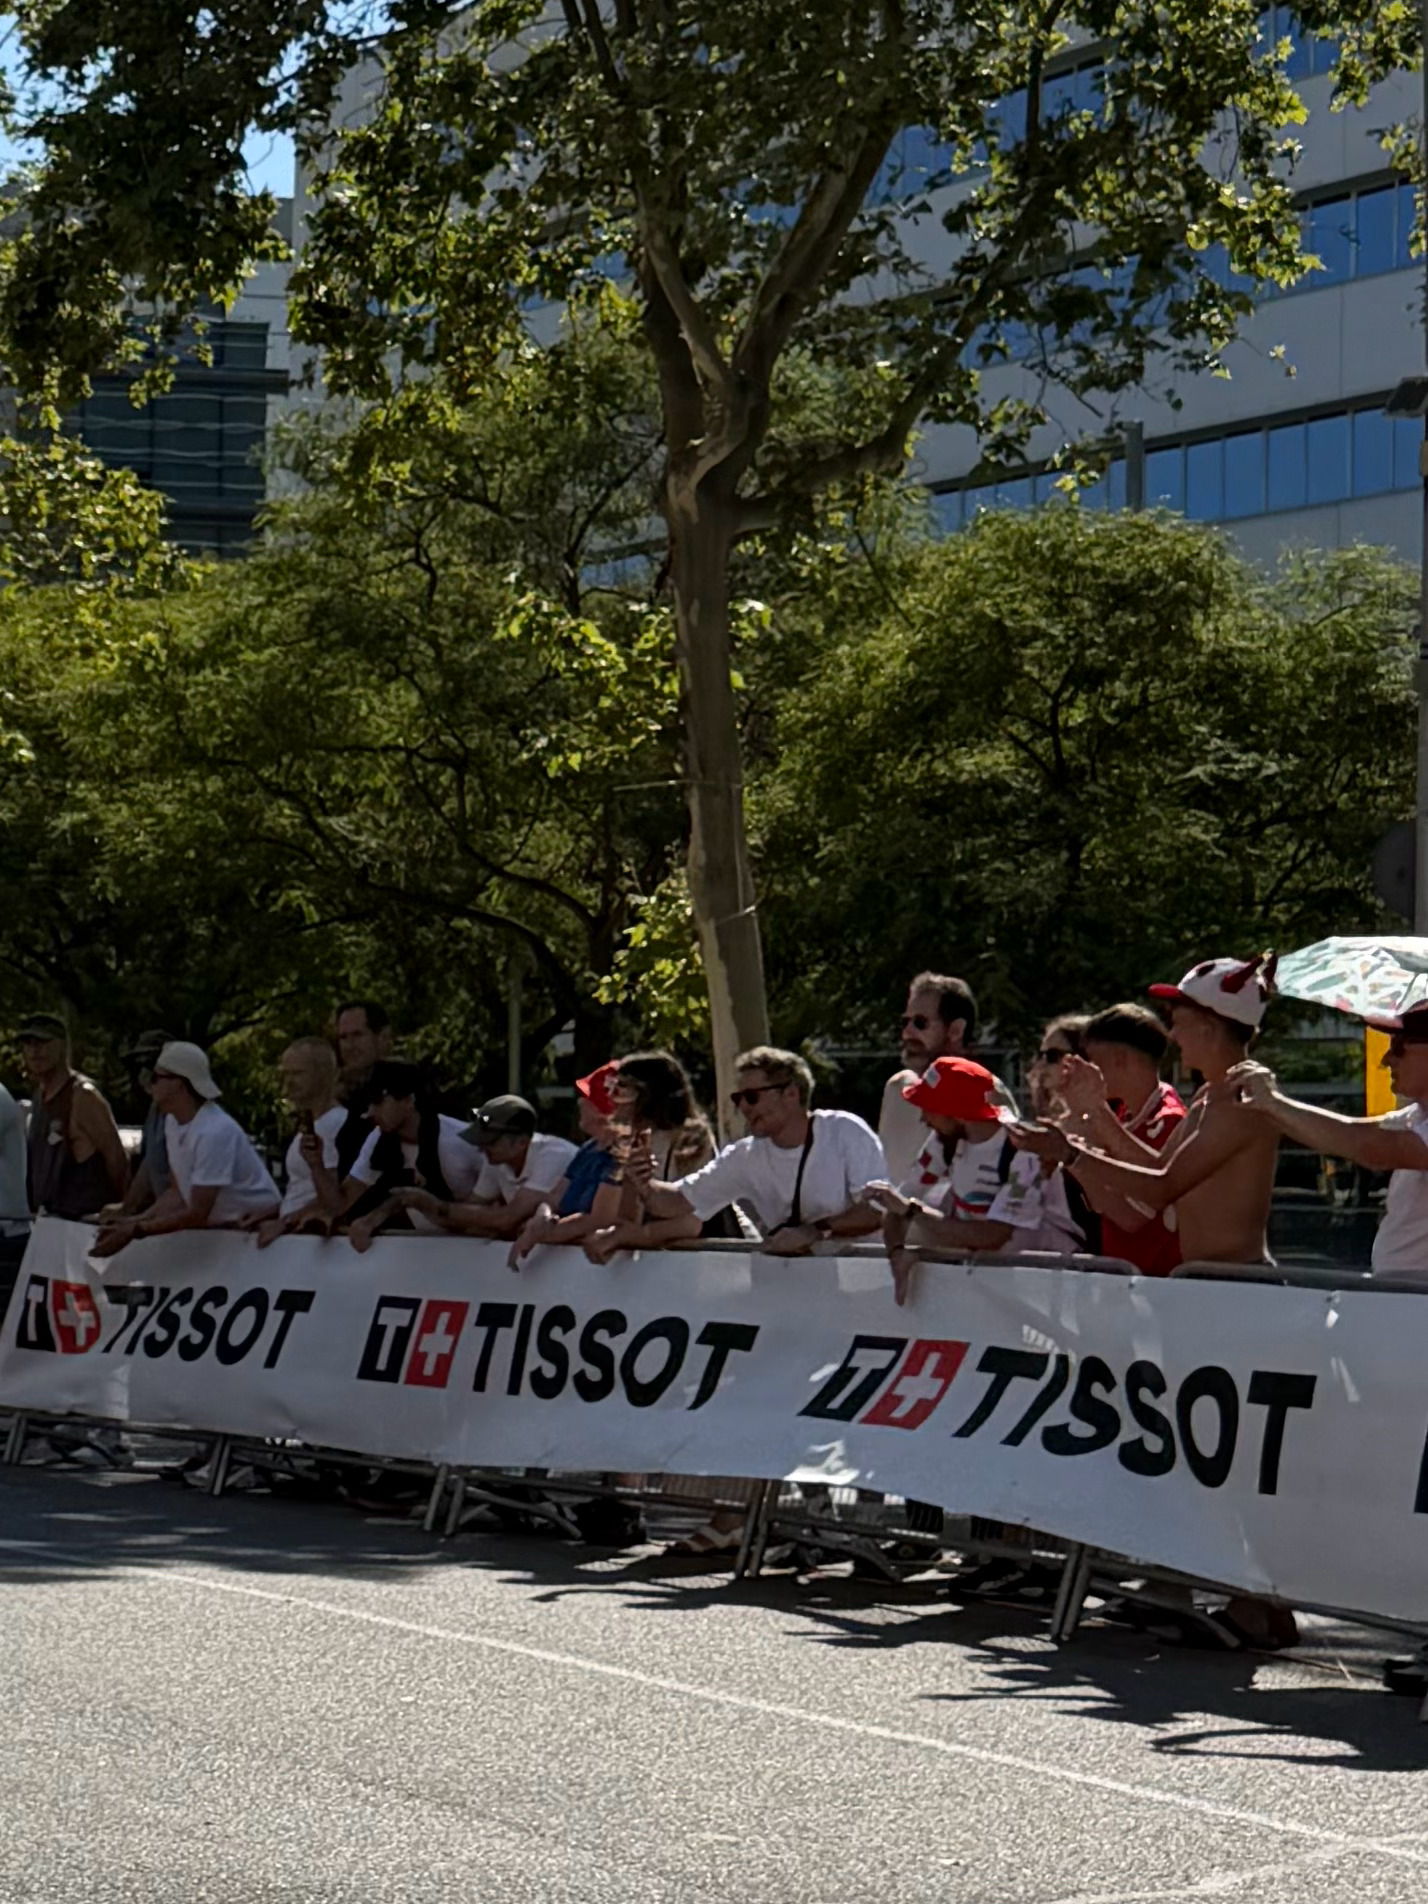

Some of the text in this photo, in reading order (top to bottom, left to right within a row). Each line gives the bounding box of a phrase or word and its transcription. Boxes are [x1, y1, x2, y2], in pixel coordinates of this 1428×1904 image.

[101, 1284, 316, 1369] TISSOT
[472, 1302, 761, 1411] TISSOT
[951, 1345, 1317, 1496] TISSOT
